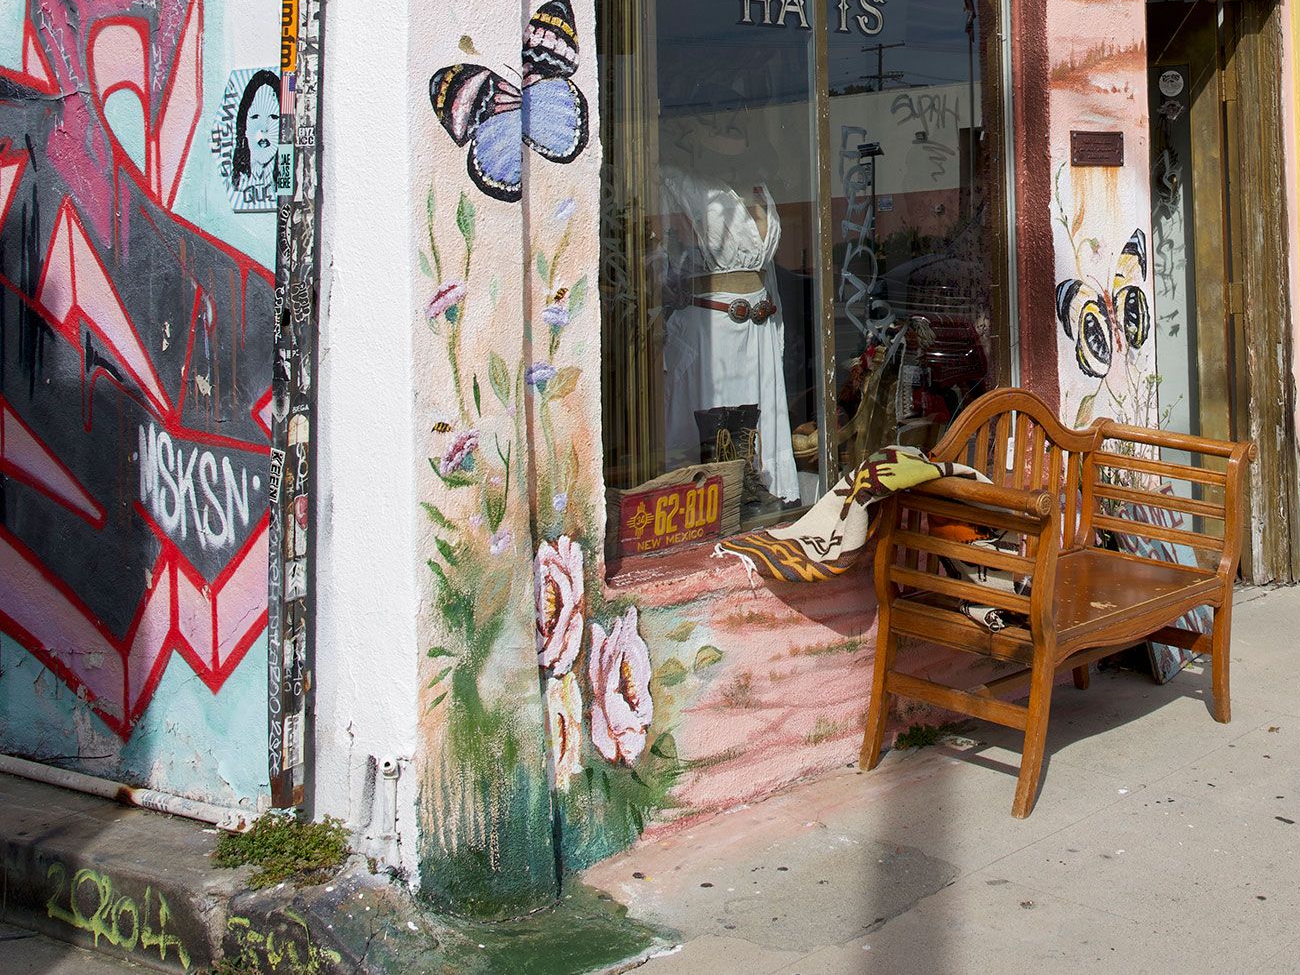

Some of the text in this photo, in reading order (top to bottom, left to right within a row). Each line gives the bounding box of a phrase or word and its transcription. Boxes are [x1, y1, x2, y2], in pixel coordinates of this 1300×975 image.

[654, 484, 719, 536] 62-810
[637, 529, 704, 552] NEW MEXICO
